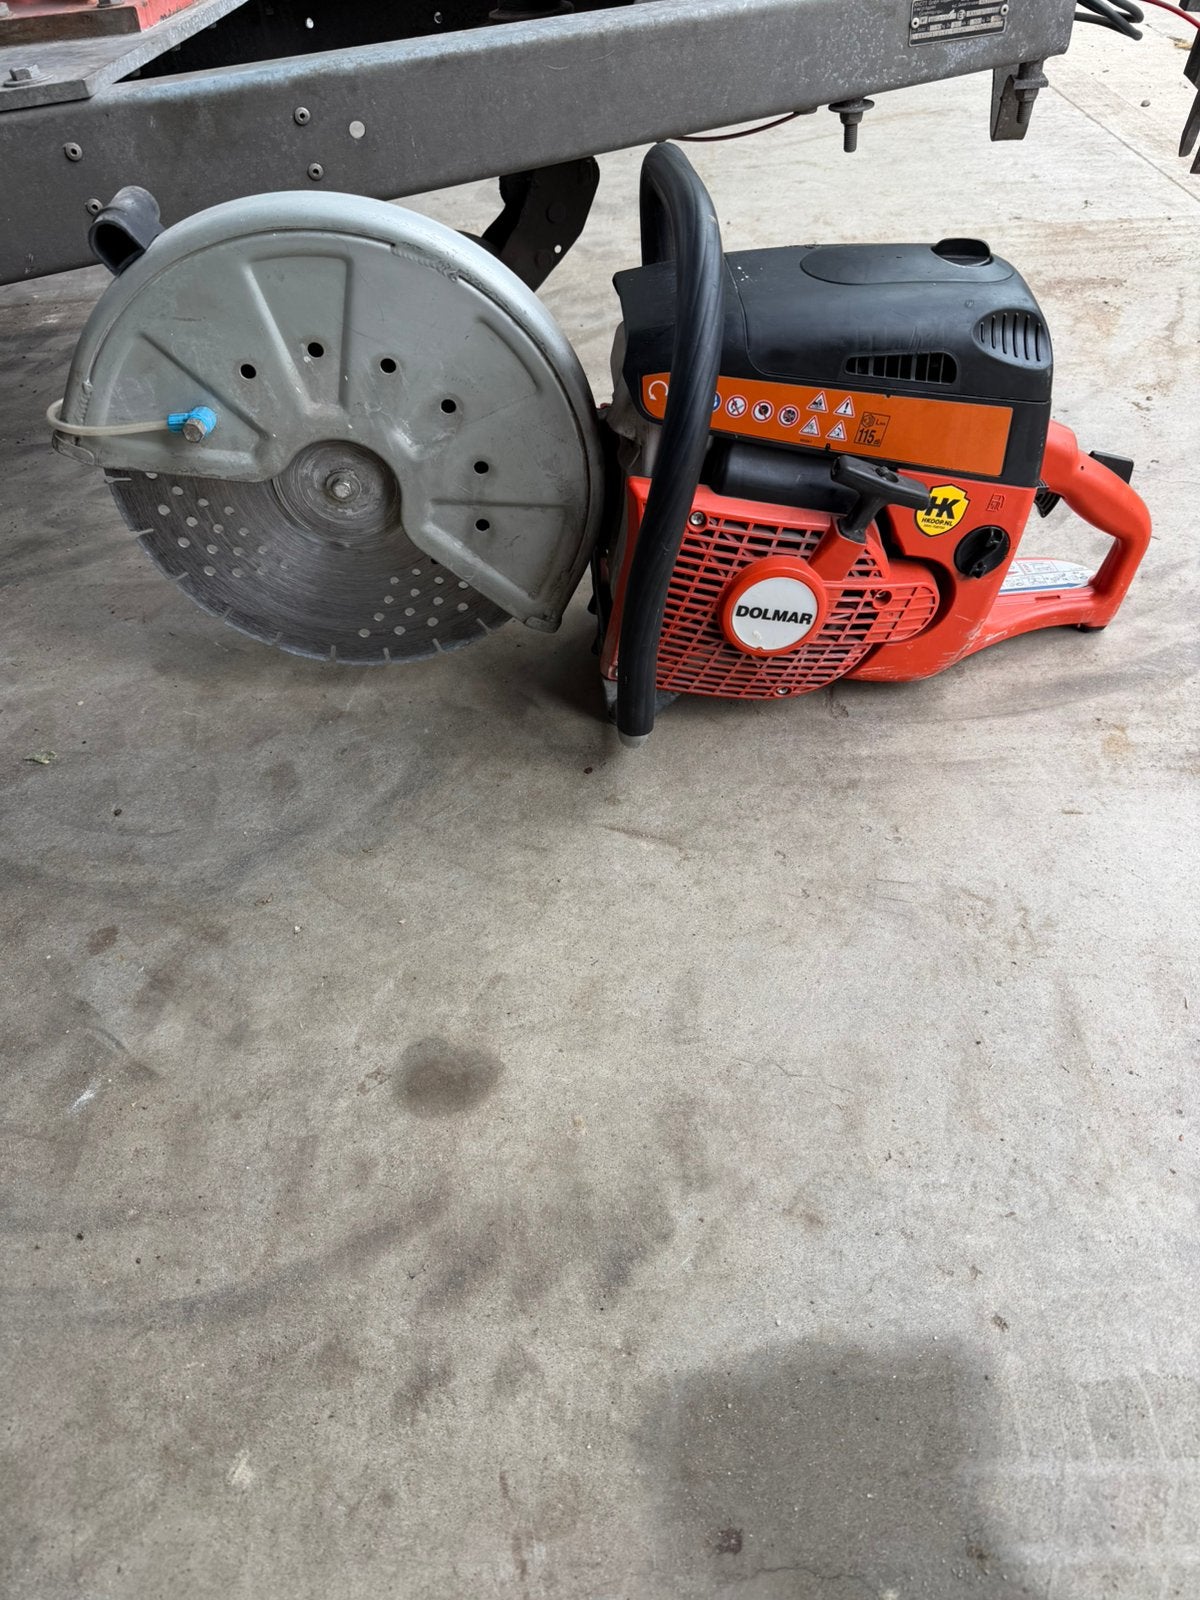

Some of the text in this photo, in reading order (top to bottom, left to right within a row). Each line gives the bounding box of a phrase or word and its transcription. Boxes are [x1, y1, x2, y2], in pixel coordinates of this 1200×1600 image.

[858, 428, 876, 443] 115
[925, 496, 961, 519] HK
[736, 605, 813, 625] DOLMAR
